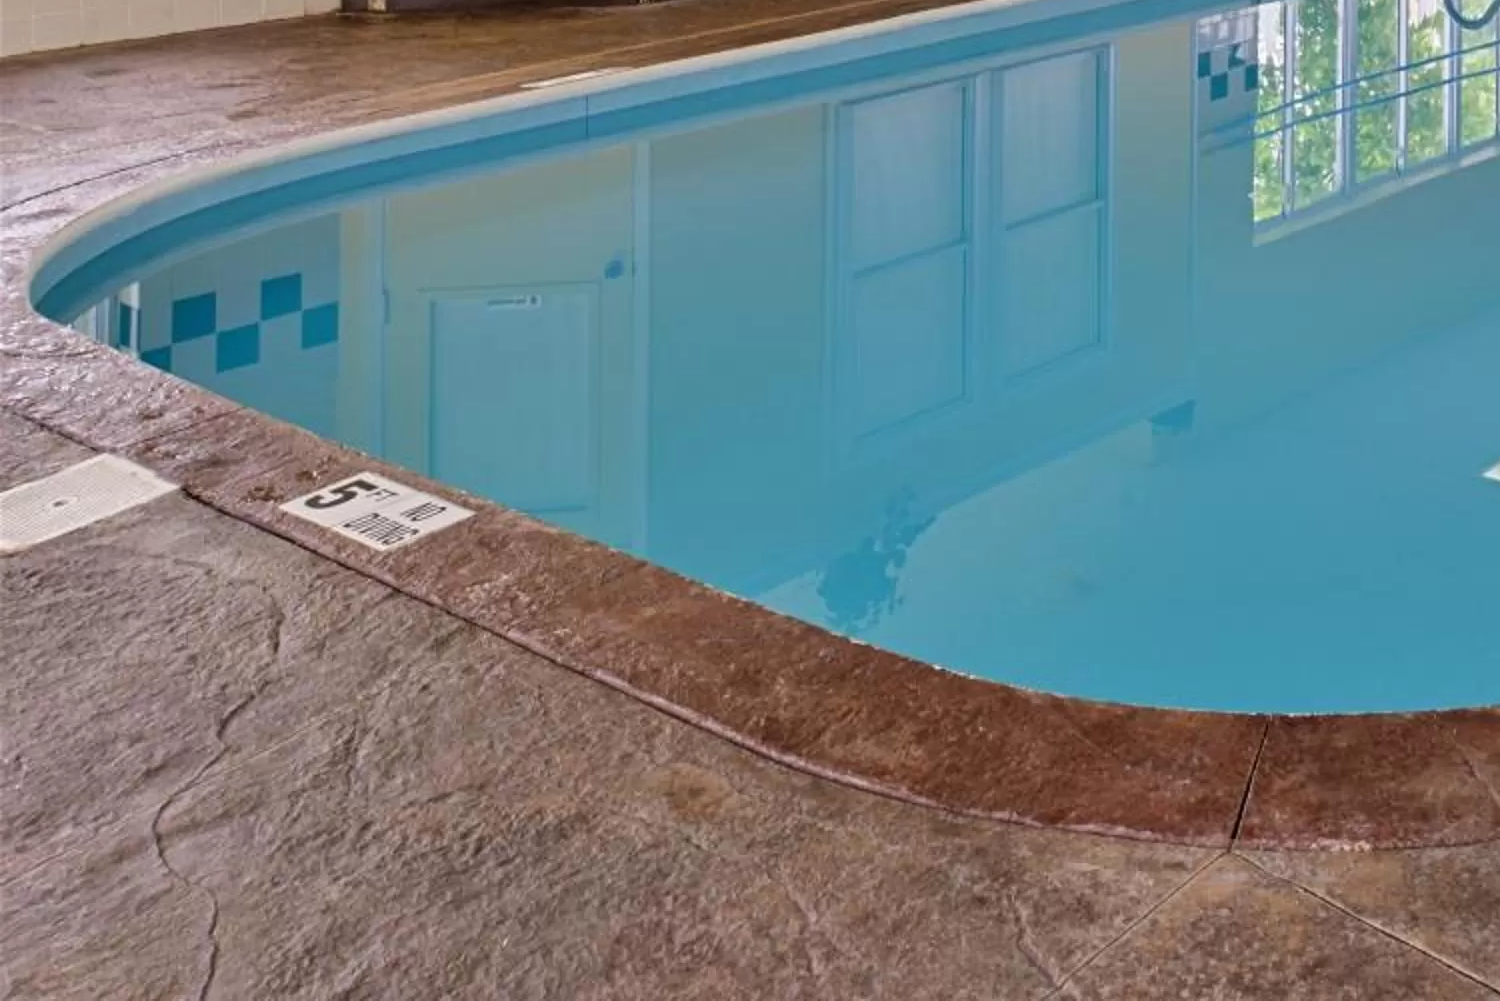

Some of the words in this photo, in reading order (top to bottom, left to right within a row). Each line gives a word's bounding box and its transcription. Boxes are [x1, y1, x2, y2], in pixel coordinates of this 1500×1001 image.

[304, 479, 379, 509] 5
[366, 488, 399, 502] FT
[402, 501, 447, 522] NO
[340, 512, 420, 546] DIVING
